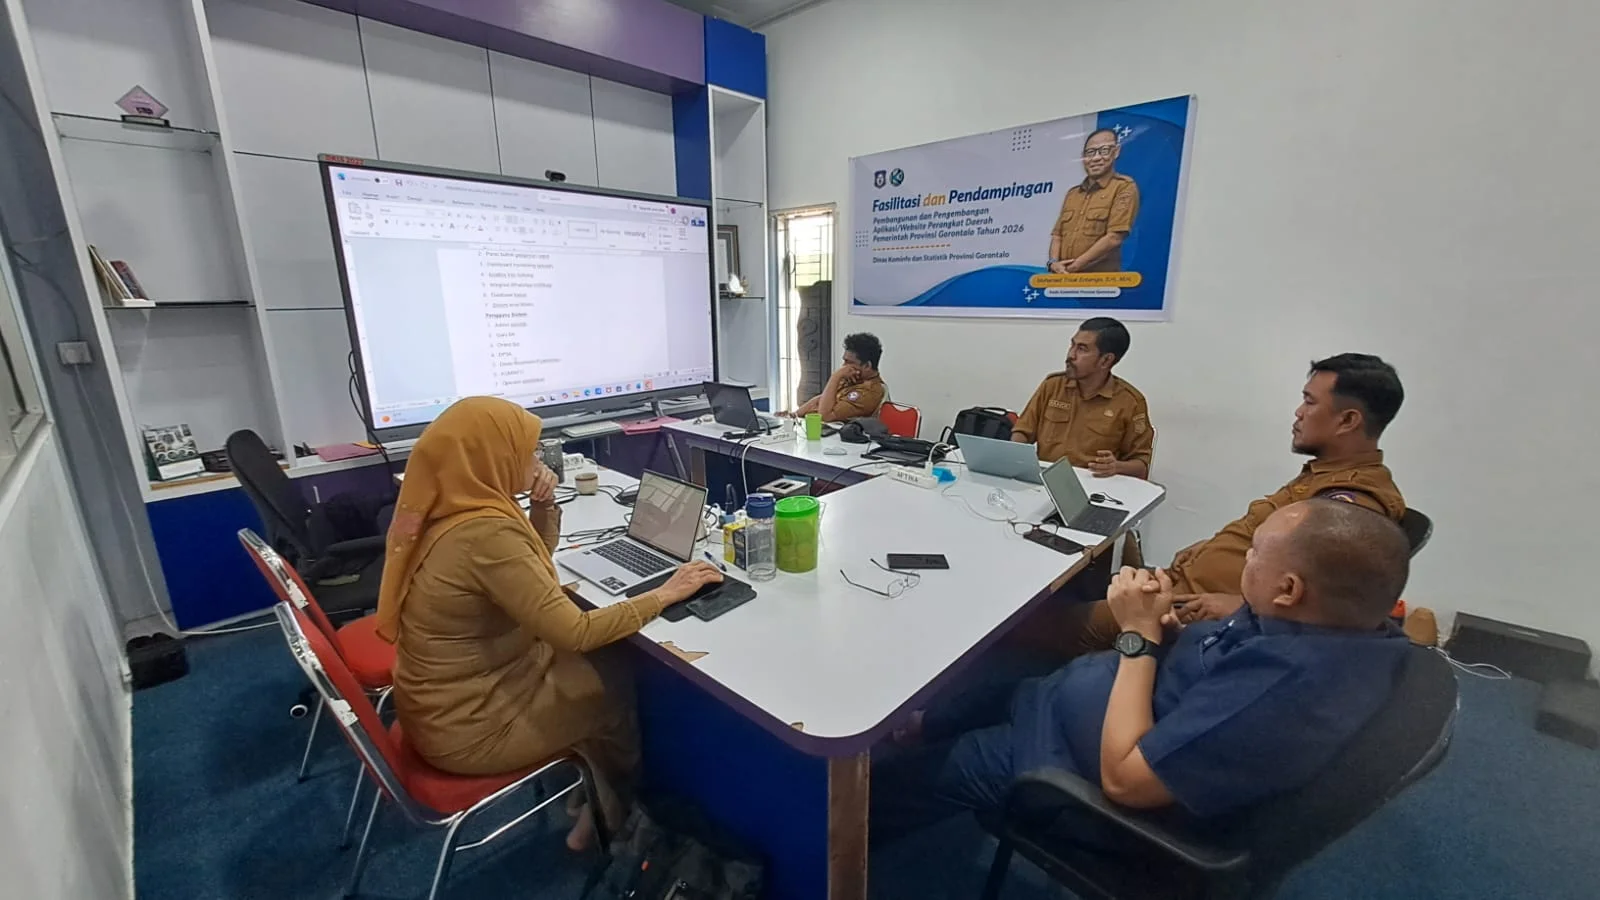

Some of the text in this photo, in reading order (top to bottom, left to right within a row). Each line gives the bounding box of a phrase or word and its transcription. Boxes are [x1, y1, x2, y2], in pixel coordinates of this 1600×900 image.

[872, 181, 1054, 212] Fasilitasi dan Pendampingan
[872, 207, 989, 224] Pembangunan dan Pengembangan
[872, 216, 993, 234] Aplikasi/Website Perangkat Daerah
[872, 224, 1025, 242] Pemerintah Provinsi Gorontalo Tahun 2026
[911, 254, 923, 262] dan
[923, 253, 948, 262] Statistik
[949, 252, 974, 261] Provinsi
[975, 250, 1010, 260] Gorontalo
